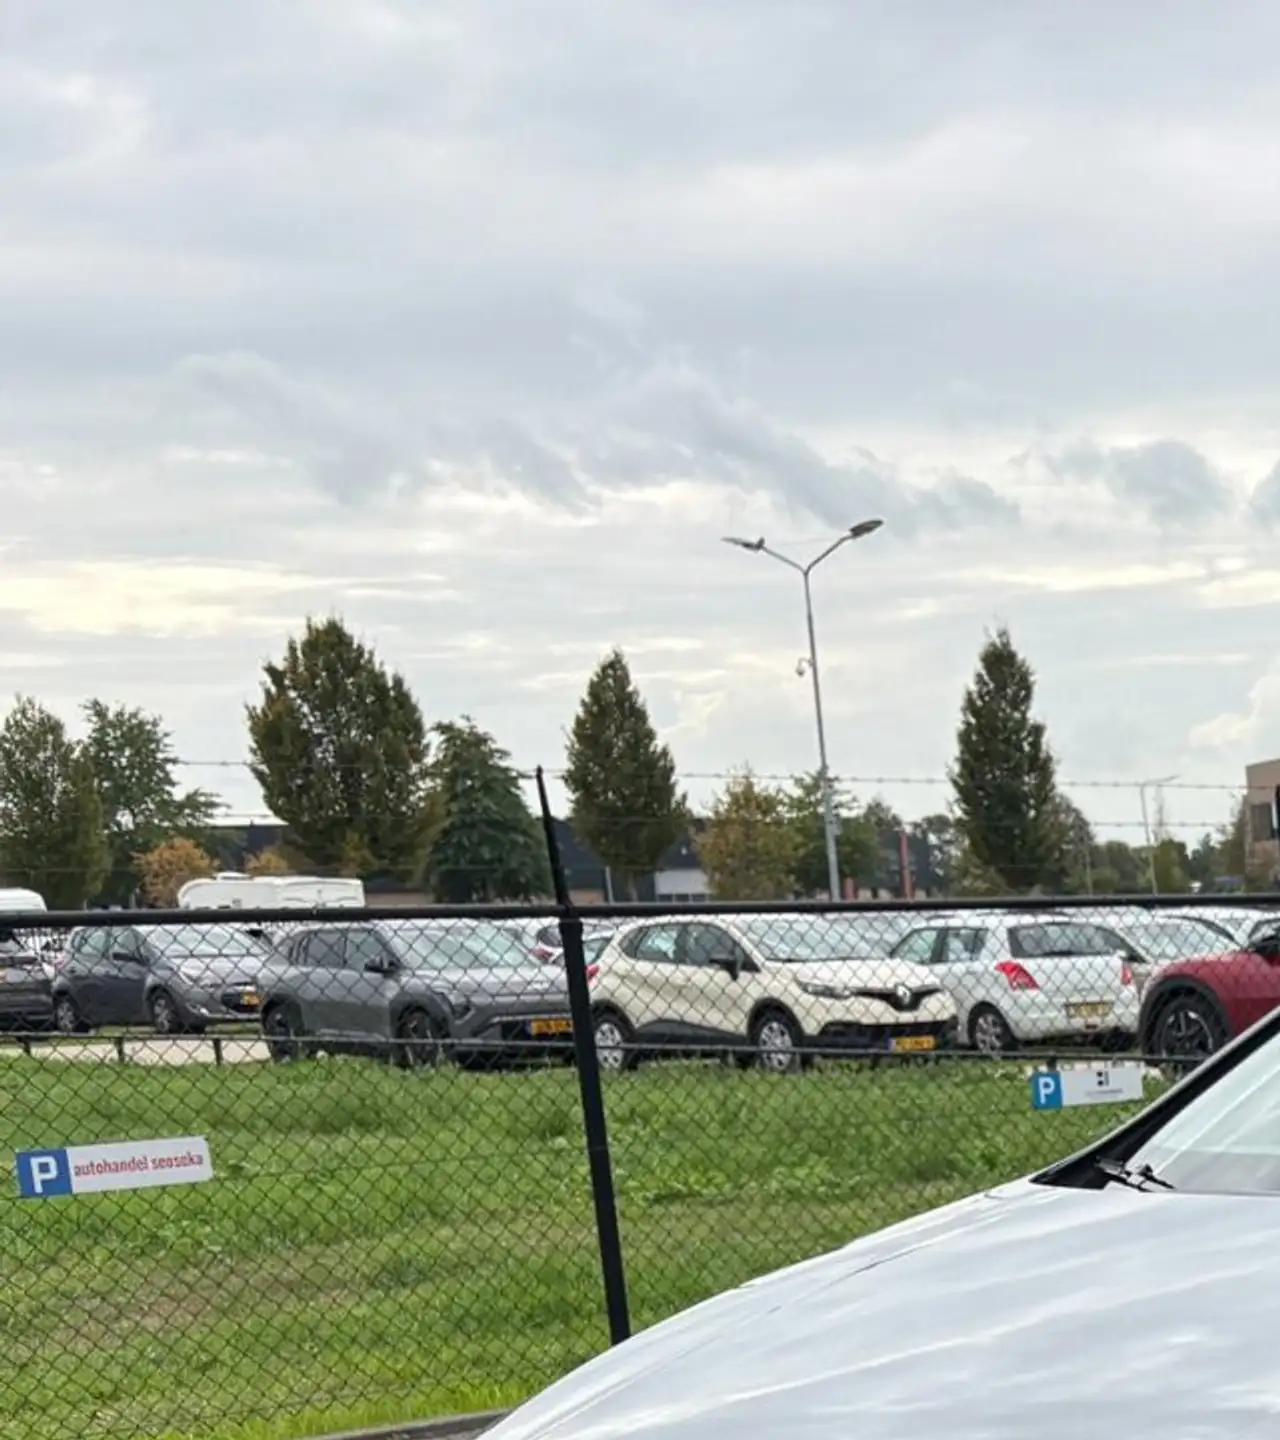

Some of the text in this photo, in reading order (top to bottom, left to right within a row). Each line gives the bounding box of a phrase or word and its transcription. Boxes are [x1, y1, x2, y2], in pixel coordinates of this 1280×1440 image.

[1038, 1076, 1056, 1105] P
[29, 1155, 58, 1194] P
[74, 1154, 149, 1177] autohandel
